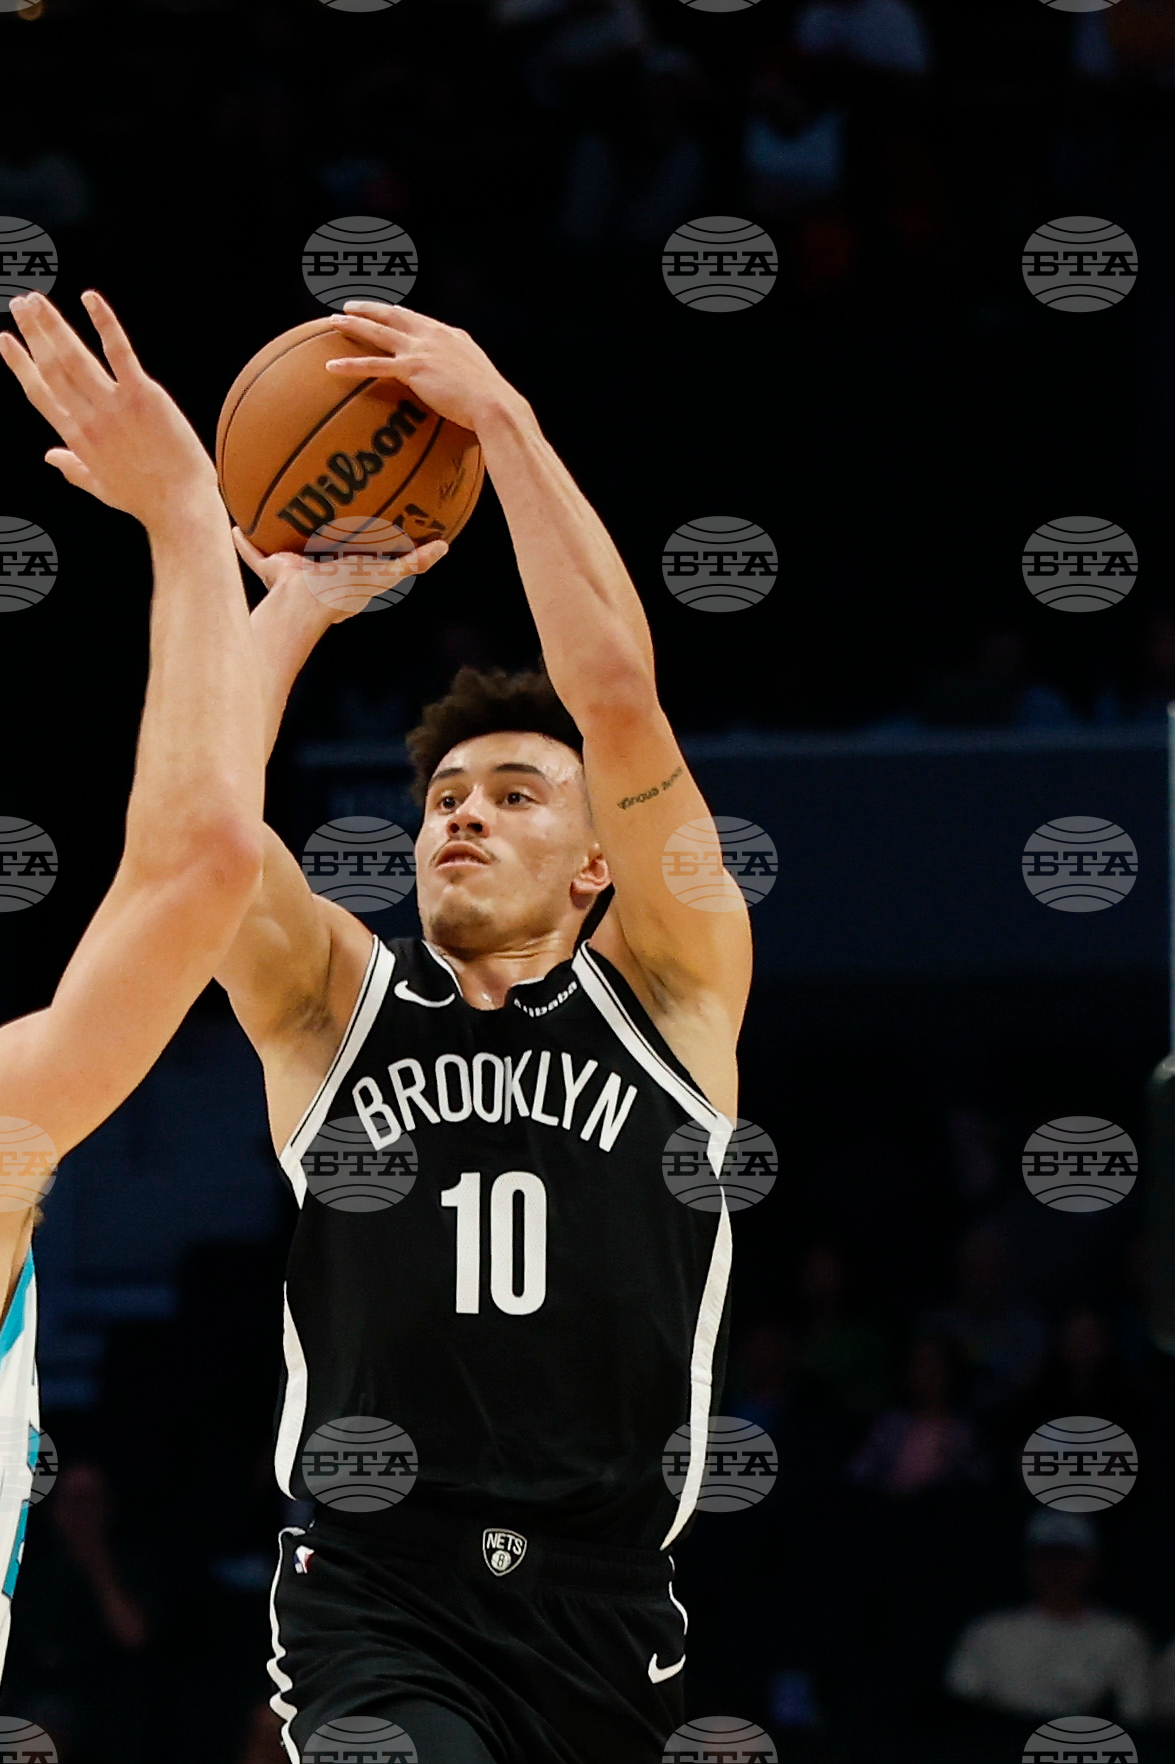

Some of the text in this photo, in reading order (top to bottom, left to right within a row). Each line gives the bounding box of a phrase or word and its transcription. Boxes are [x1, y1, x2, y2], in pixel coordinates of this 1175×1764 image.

[278, 400, 426, 538] Wilson
[352, 1049, 639, 1153] BROOKLYN
[440, 1170, 547, 1315] 10
[486, 1532, 523, 1556] NETS
